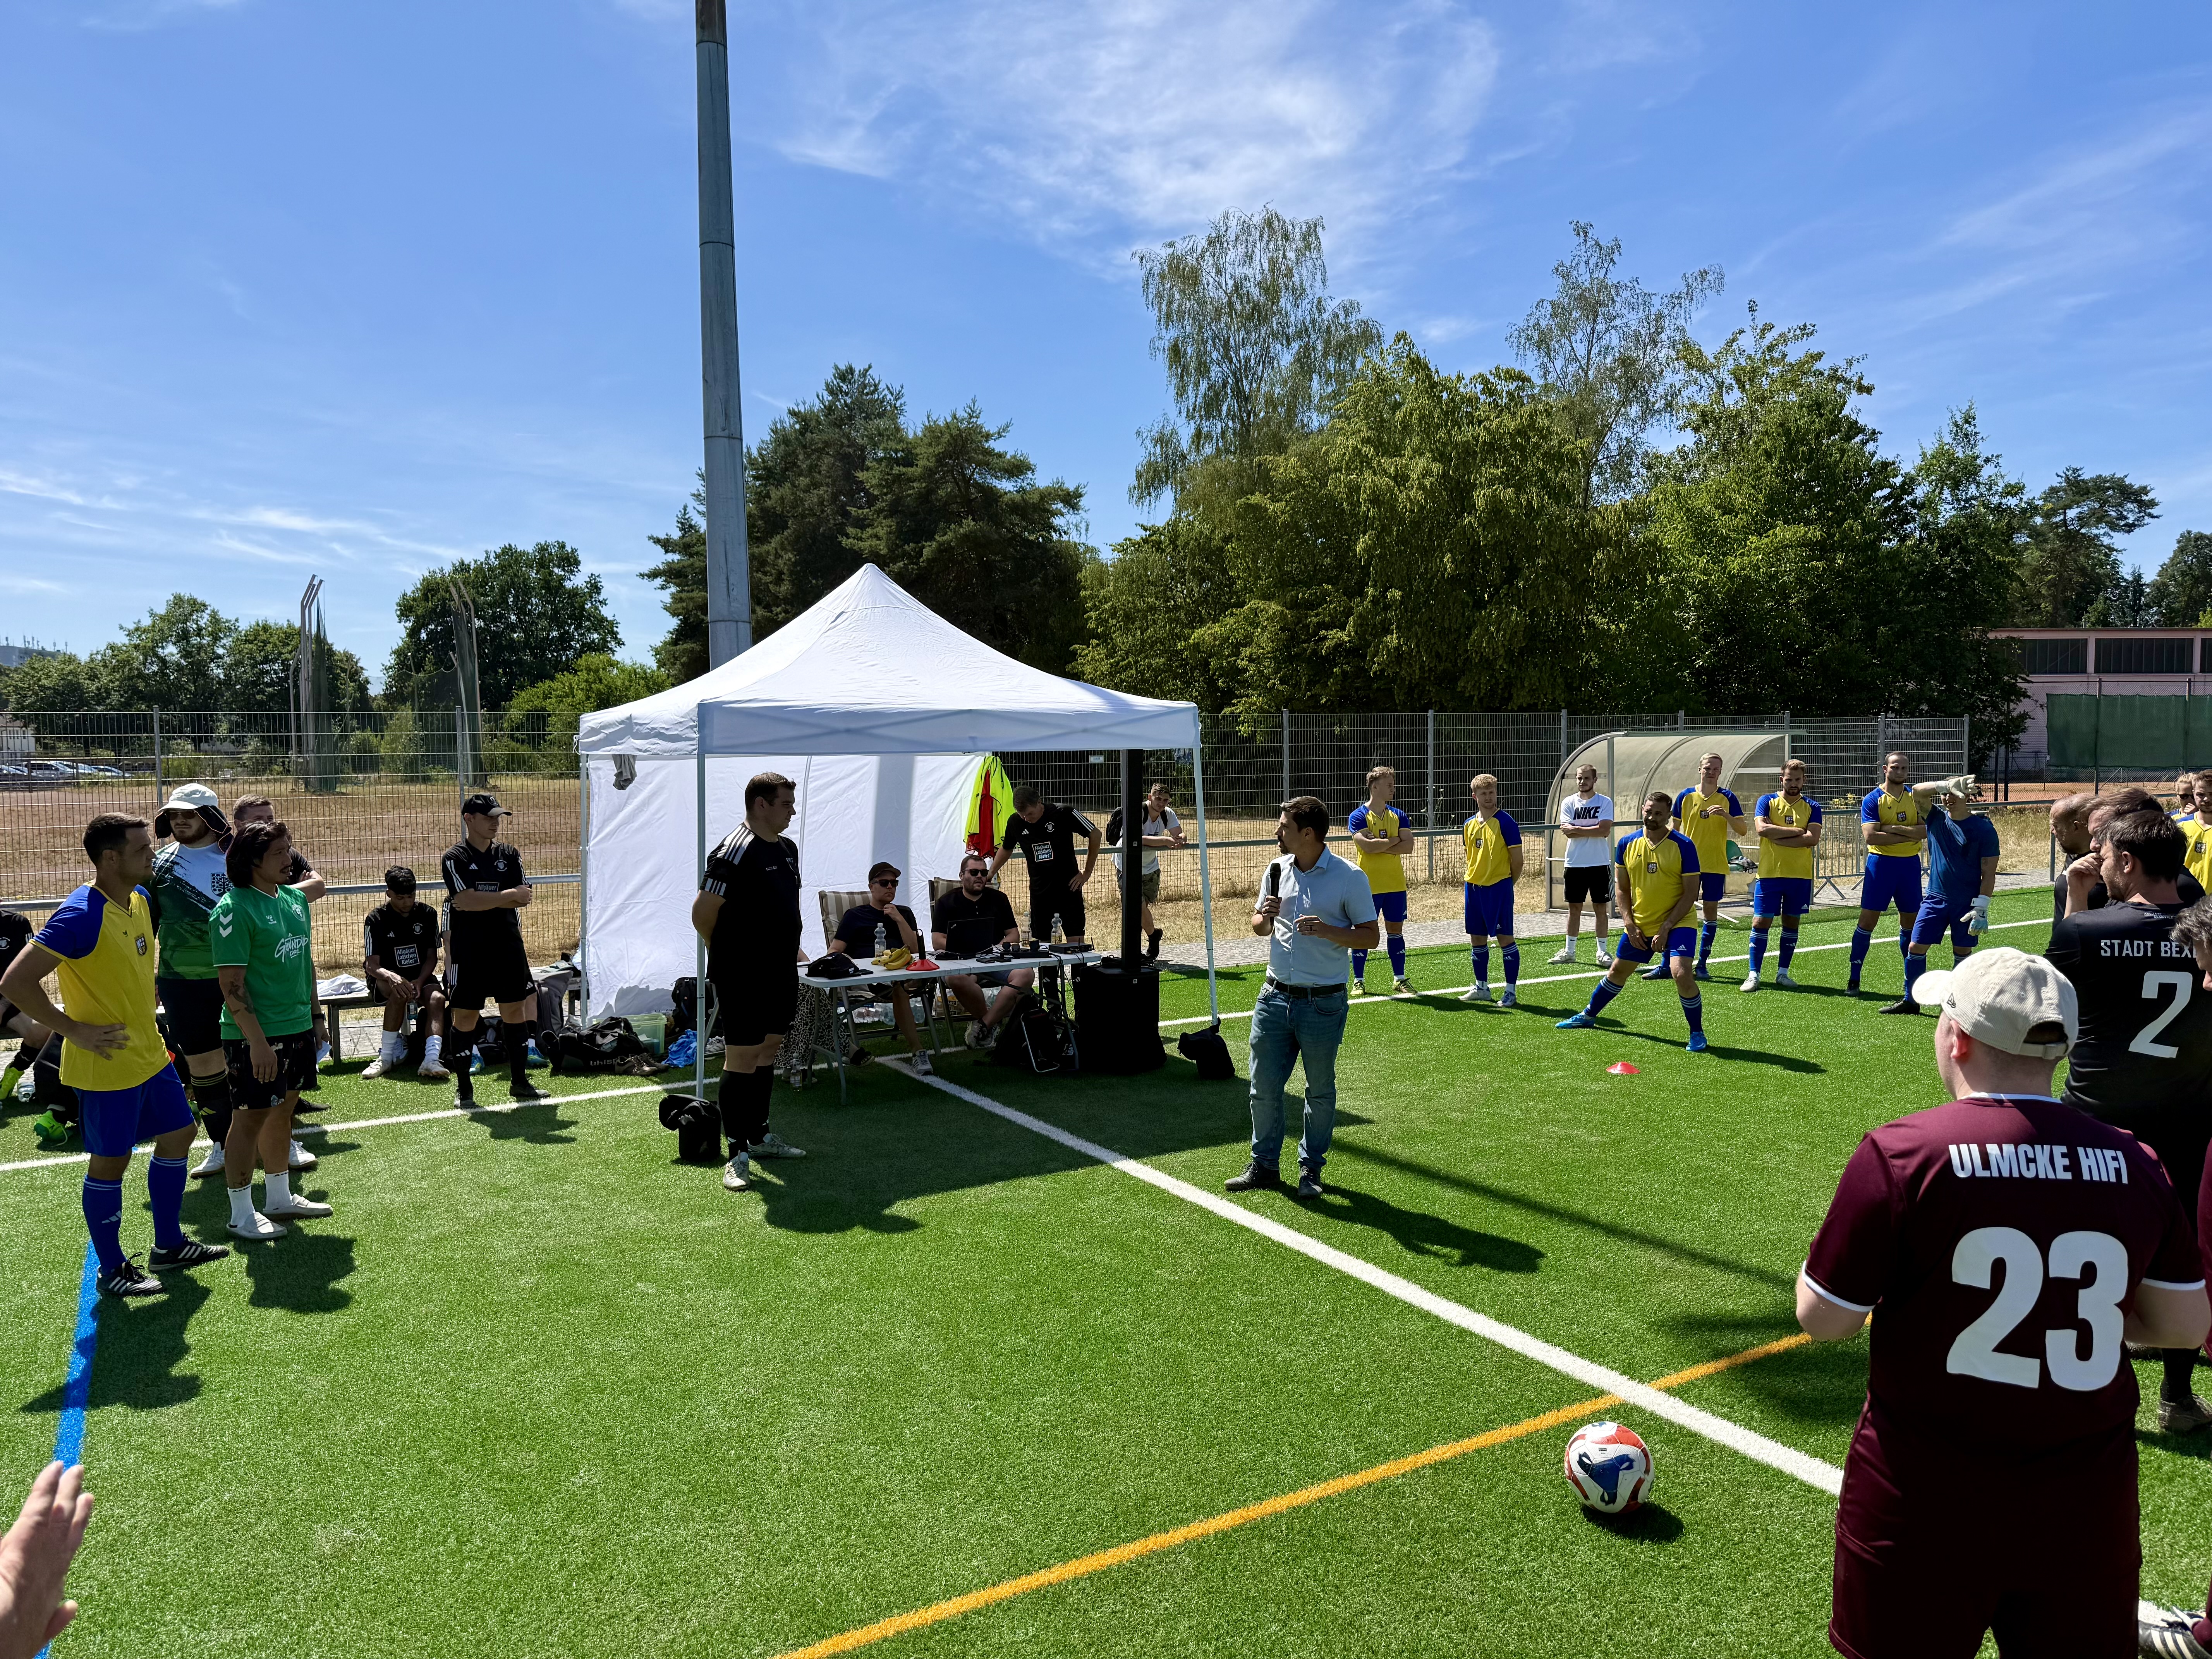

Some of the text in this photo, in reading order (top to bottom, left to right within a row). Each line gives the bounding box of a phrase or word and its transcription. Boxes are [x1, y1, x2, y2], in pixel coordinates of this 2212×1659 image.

[1573, 806, 1601, 820] NIKE
[2101, 939, 2154, 957] STADT
[2128, 970, 2193, 1058] 2
[1949, 1144, 2128, 1184] ULMCKE HIFI
[1947, 1227, 2128, 1391] 23
